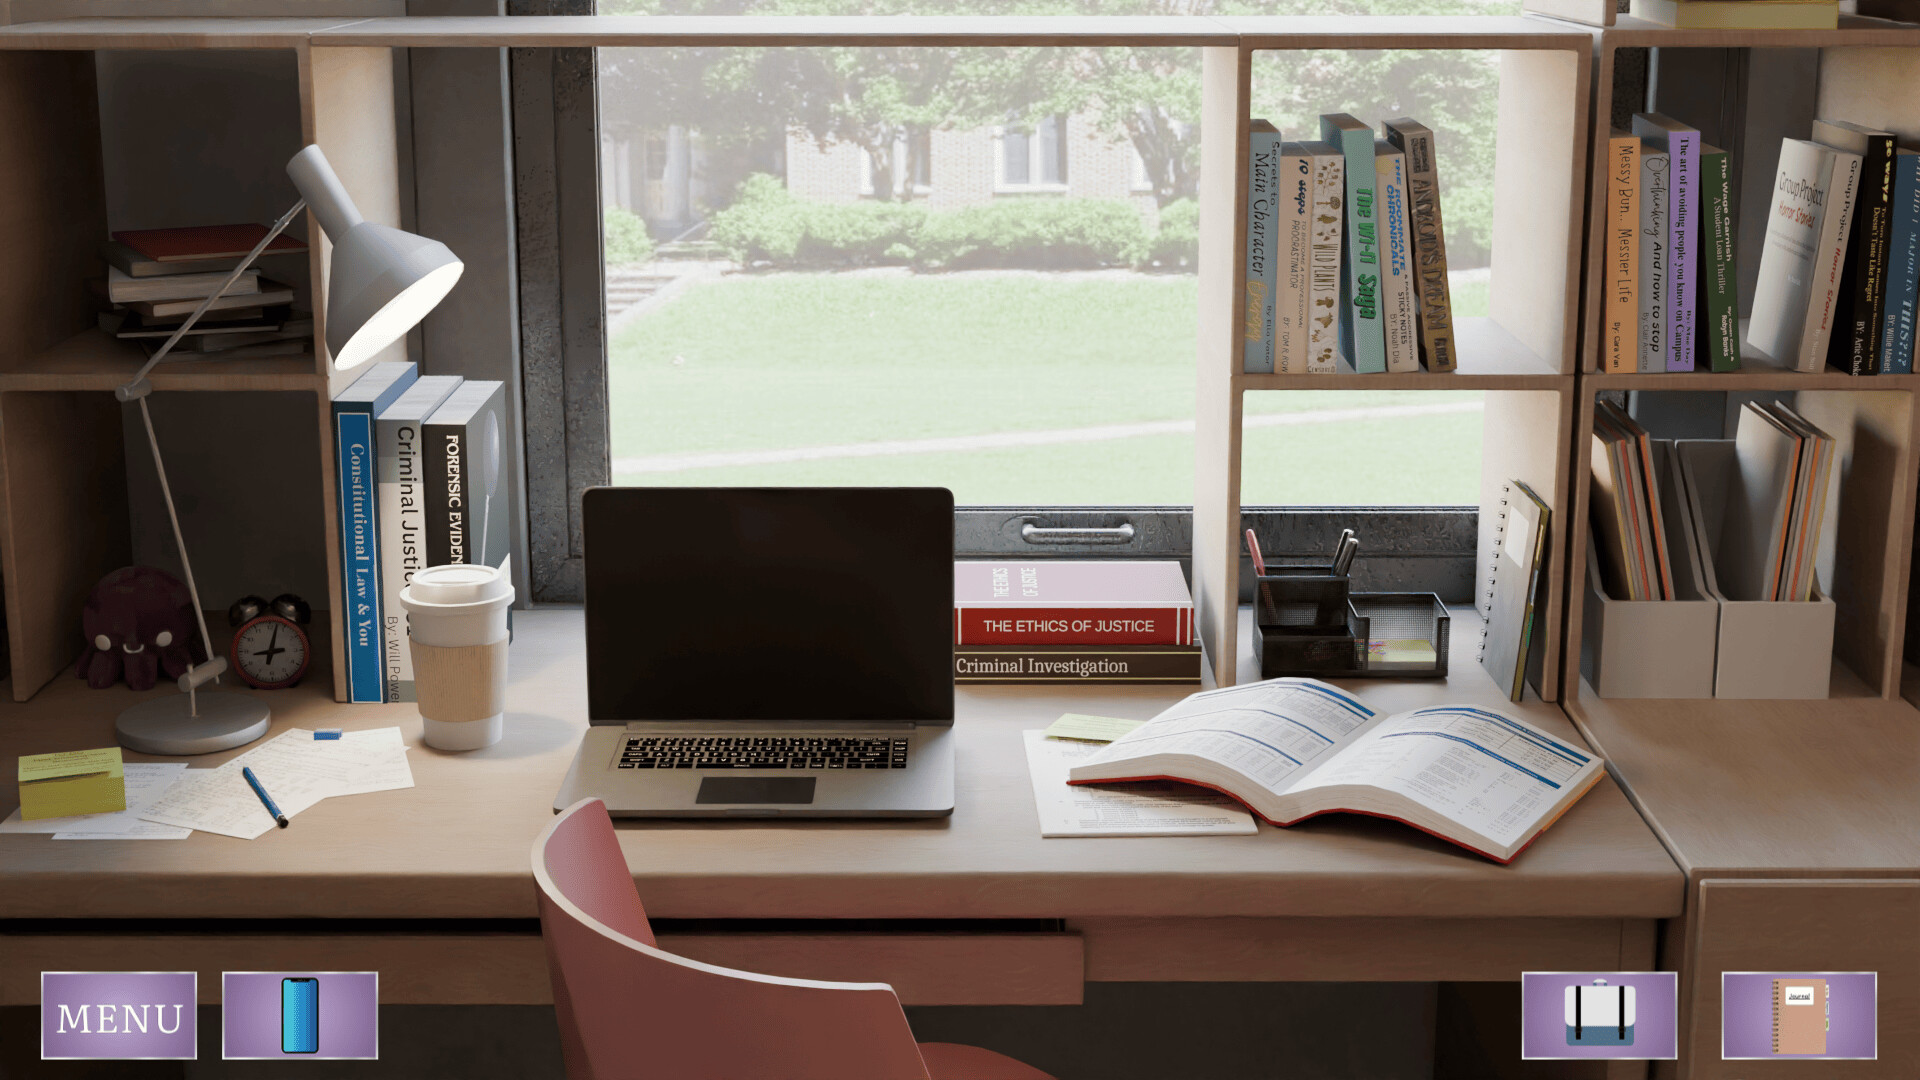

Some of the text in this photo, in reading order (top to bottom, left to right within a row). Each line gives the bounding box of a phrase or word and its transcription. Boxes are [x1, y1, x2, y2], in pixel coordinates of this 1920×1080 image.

[1680, 137, 1689, 156] The
[1255, 153, 1270, 193] Main
[1271, 142, 1279, 205] Secrets to
[1299, 160, 1308, 174] 10
[1616, 146, 1633, 184] Messy
[1680, 175, 1688, 185] of
[1294, 180, 1306, 215] steps
[1780, 171, 1824, 206] Group Project
[1882, 161, 1891, 203] ways
[1357, 188, 1373, 217] The
[1676, 188, 1687, 227] avoiding
[1795, 207, 1816, 229] Stories
[1387, 184, 1400, 276] CHRONICALS
[1395, 188, 1406, 271] ROOMMATE
[1714, 206, 1723, 238] Student
[1872, 207, 1880, 235] Doesn't
[1252, 199, 1270, 277] Character
[1289, 220, 1300, 288] PROCRASTINATOR
[1675, 231, 1686, 260] people
[1716, 240, 1724, 260] Loan
[1821, 160, 1858, 330] Group Project Horror Stories
[1870, 238, 1878, 258] Taste
[1906, 231, 1917, 274] MAJOR
[1644, 157, 1669, 352] Overthinking And how to stop
[1674, 263, 1684, 279] you
[1717, 262, 1726, 294] Thriller
[1906, 279, 1912, 293] IN
[1354, 274, 1377, 319] Saga
[1422, 268, 1447, 330] DREAM
[1618, 280, 1632, 303] Life
[1676, 283, 1685, 307] know
[1865, 278, 1874, 302] Regret
[1266, 306, 1271, 317] By
[1676, 310, 1683, 321] on
[1720, 315, 1728, 335] Robyn
[1672, 324, 1684, 362] Campus
[1852, 321, 1865, 376] BY: Artie Choke
[1886, 328, 1894, 347] Willie
[397, 425, 422, 588] Criminal Justic
[446, 434, 463, 565] FORENSIC EVIDEN
[350, 443, 371, 647] Constitutional Law & You
[384, 616, 399, 636] By:
[984, 620, 1155, 632] THE ETHICS OF JUSTICE
[388, 640, 401, 662] Will
[956, 657, 1129, 677] Criminal Investigation
